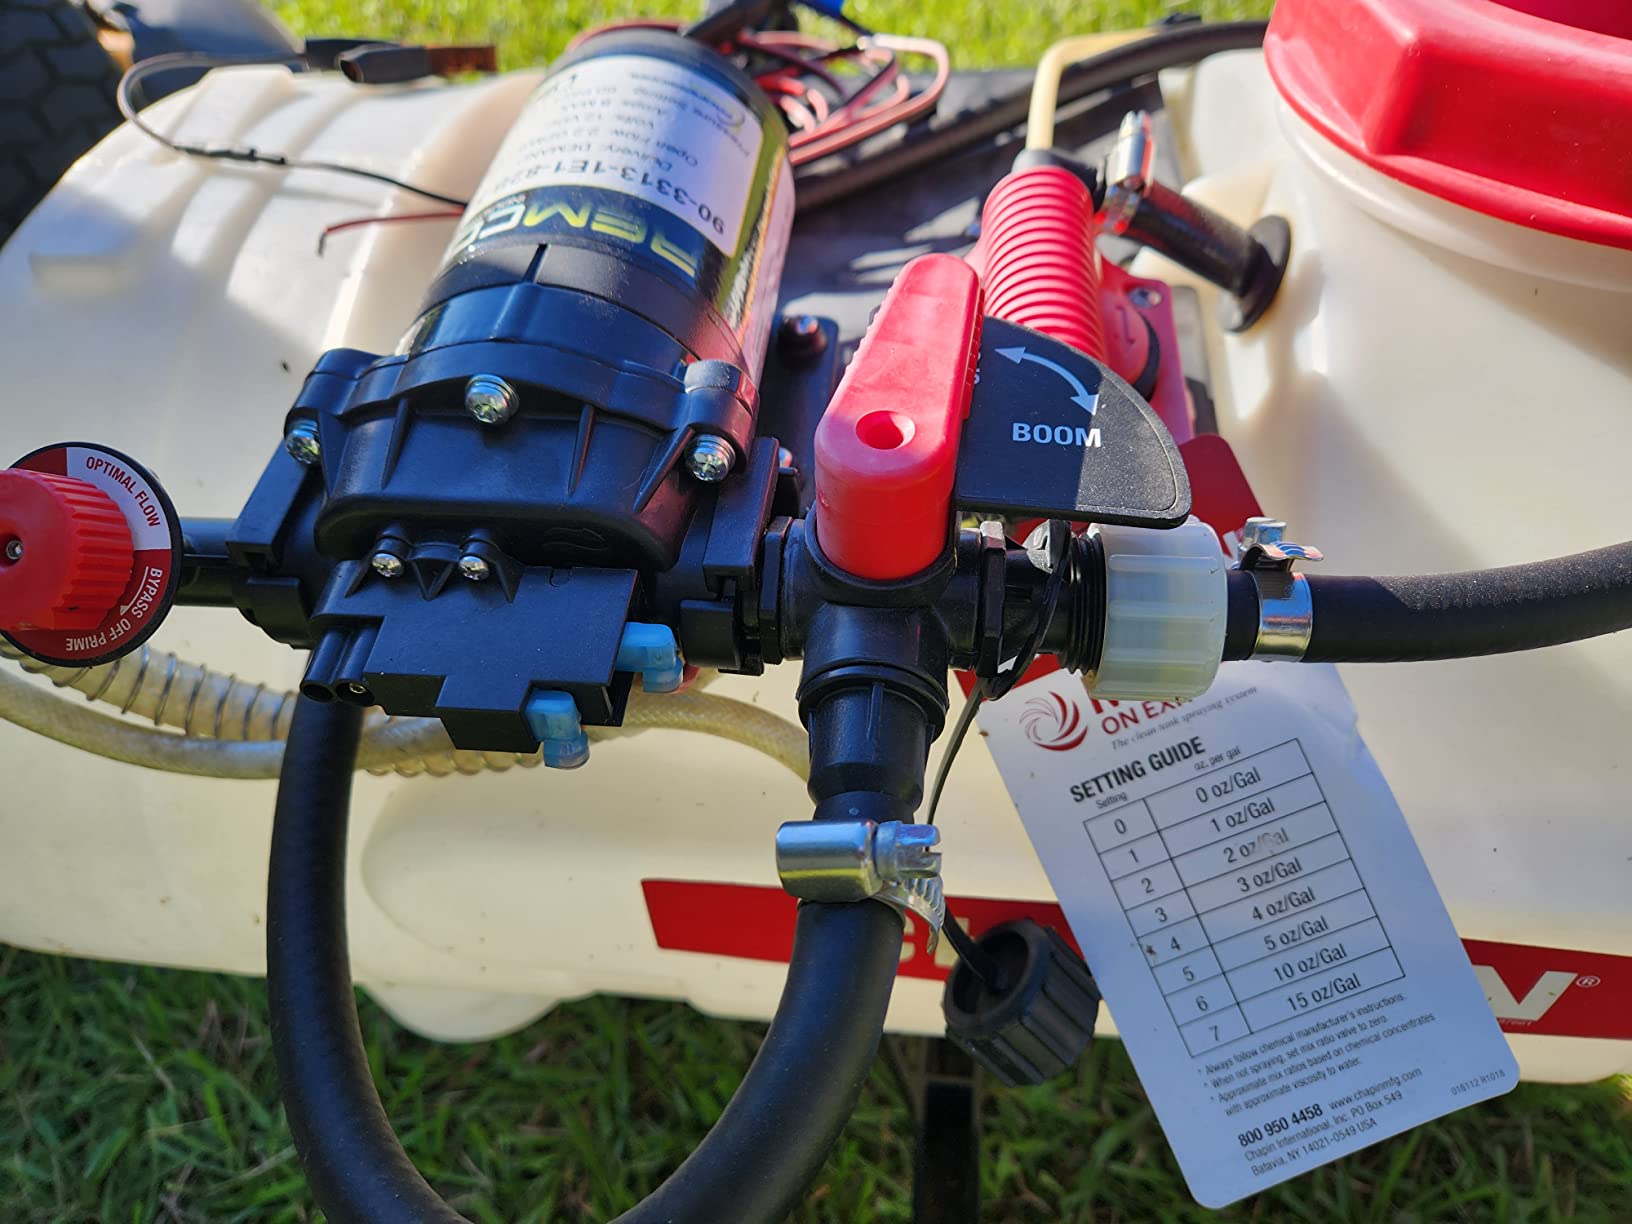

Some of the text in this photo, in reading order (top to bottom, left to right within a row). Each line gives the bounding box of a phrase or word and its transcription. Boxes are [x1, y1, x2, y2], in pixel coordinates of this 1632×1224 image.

[1012, 422, 1102, 448] BOOM
[86, 456, 162, 528] OPTIMAL FLOW
[66, 567, 164, 652] BYPASS OFF PRIME
[1102, 707, 1140, 736] ON
[1110, 737, 1129, 750] The
[1193, 745, 1241, 771] oz. per gal
[1068, 735, 1206, 803] SETTING GUIDE
[1194, 766, 1262, 804] 0 oz/Gal
[1095, 790, 1128, 810] Setting
[1210, 796, 1276, 833] 1 oz/Gal
[1113, 817, 1128, 835] 0
[1128, 848, 1139, 864] 1
[1222, 846, 1237, 864] 2
[1140, 876, 1155, 894] 2
[1236, 856, 1303, 893] 3 oz/Gal
[1154, 906, 1168, 923] 3
[1251, 885, 1316, 921] 4 oz/Gal
[1169, 935, 1181, 952] 4
[1263, 914, 1329, 951] 5 oz/Gal
[1181, 965, 1195, 982] 5
[1273, 942, 1348, 982] 10 oz/Gal
[1195, 994, 1209, 1012] 6
[1287, 972, 1361, 1012] 15 oz/Gal
[1204, 1056, 1234, 1076] Always
[1232, 1047, 1259, 1063] follow
[1257, 1031, 1295, 1054] chemical
[1355, 991, 1406, 1017] instructions.
[1208, 1024, 1221, 1042] 7
[1210, 1072, 1235, 1089] When
[1234, 1065, 1250, 1079] not
[1285, 1046, 1300, 1059] set
[1299, 1040, 1316, 1054] mix
[1314, 1033, 1336, 1048] ratio
[1335, 1024, 1358, 1040] valve
[1356, 1021, 1367, 1032] to
[1217, 1011, 1436, 1104] Approximate mix ratios based on chemical concentrates
[1224, 1101, 1243, 1117] with
[1242, 1082, 1292, 1110] approximate
[1291, 1068, 1328, 1090] viscosity
[1325, 1064, 1337, 1076] to
[1237, 1126, 1264, 1148] 800
[1263, 1116, 1290, 1137] 950
[1290, 1102, 1324, 1126] 4458
[1243, 1141, 1277, 1162] Chapin
[1349, 1104, 1366, 1118] PO
[1364, 1098, 1384, 1113] Box
[1383, 1089, 1403, 1105] 549
[1250, 1117, 1378, 1176] Batavia, NY 14021-0549 USA
